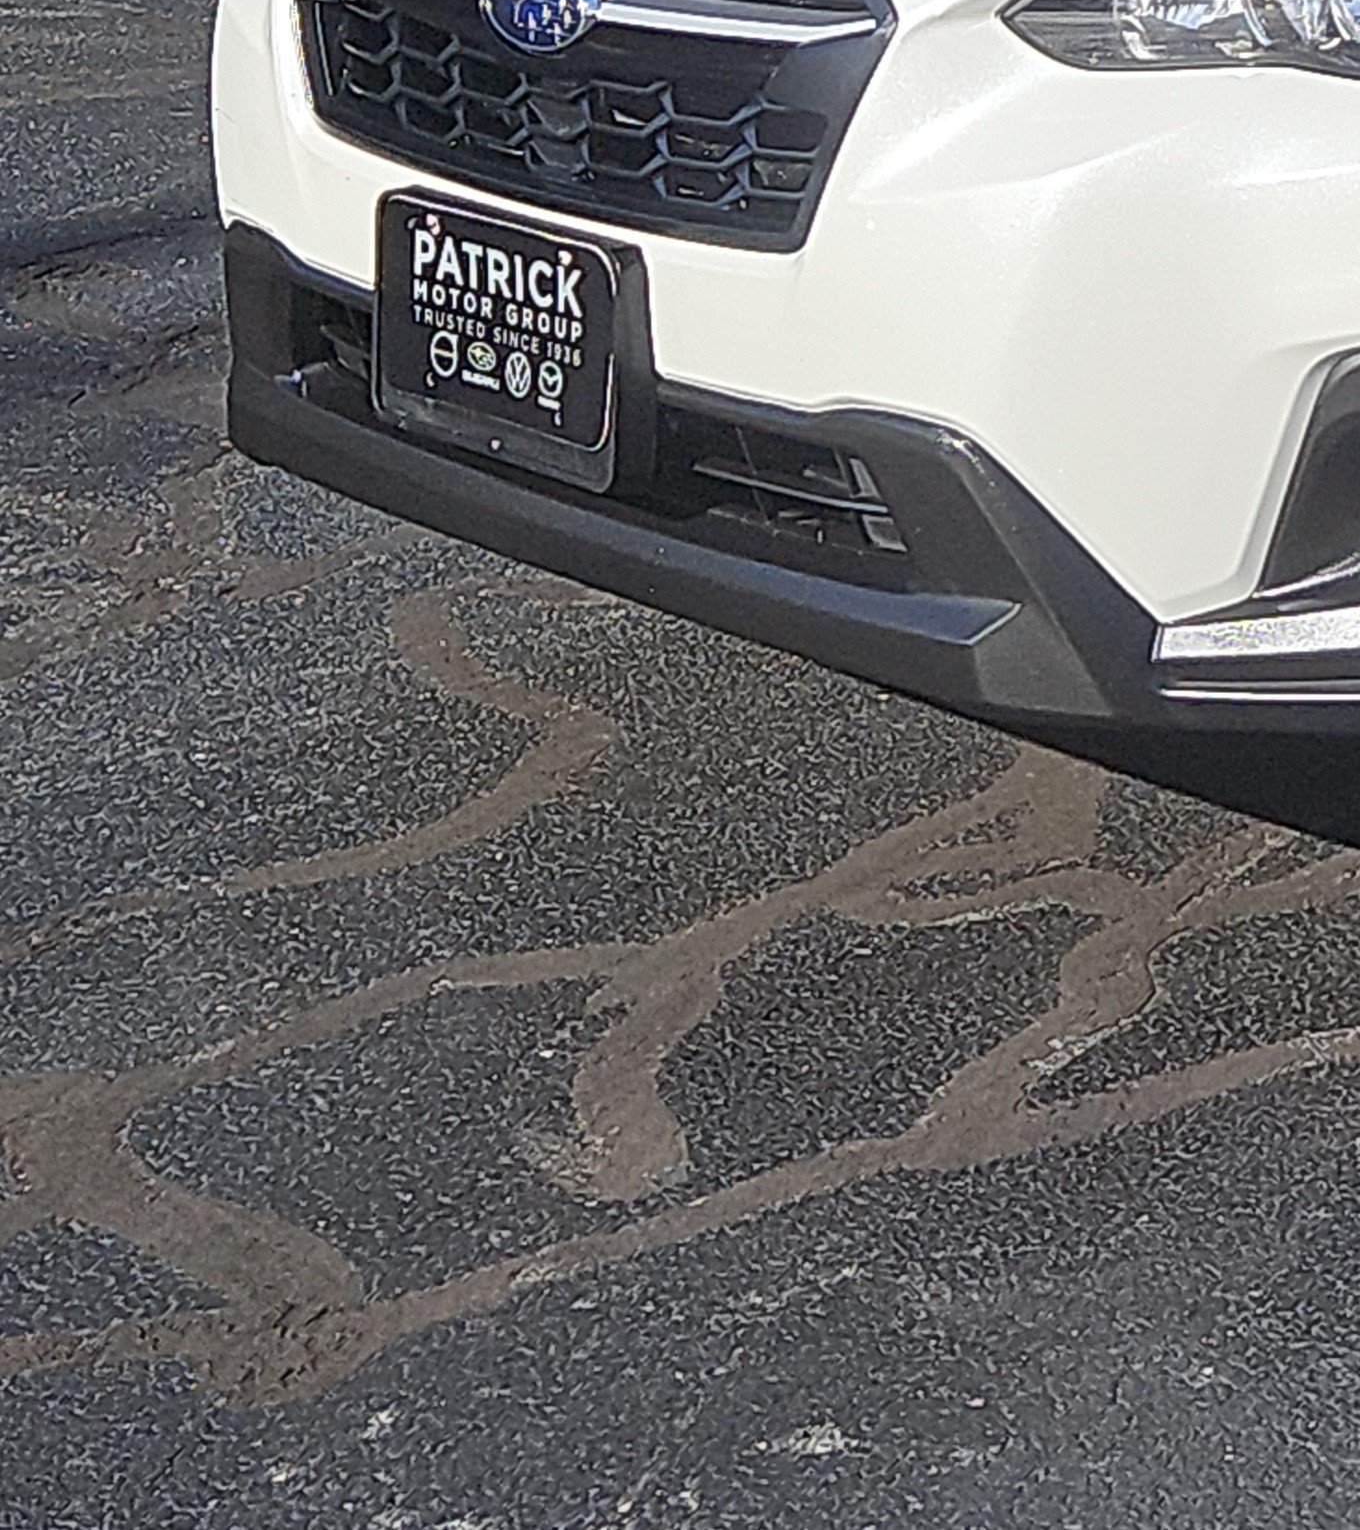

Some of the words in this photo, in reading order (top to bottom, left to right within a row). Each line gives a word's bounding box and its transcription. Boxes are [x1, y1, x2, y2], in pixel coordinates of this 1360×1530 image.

[412, 228, 584, 319] PATRICK
[412, 278, 494, 320] MOTOR
[504, 302, 584, 343] GROUP
[413, 304, 487, 340] TRUSTED
[493, 325, 540, 356] SINCE
